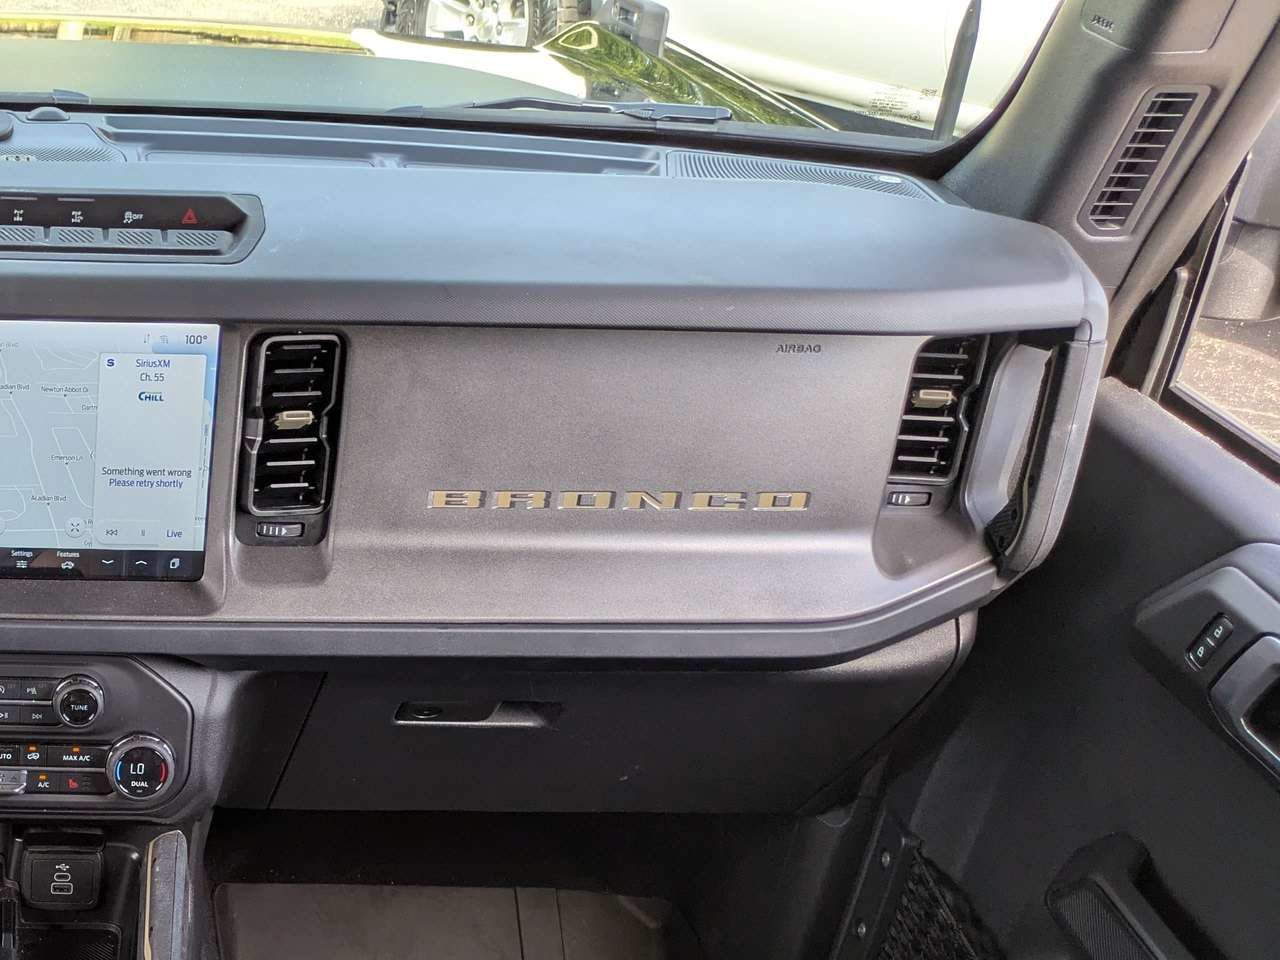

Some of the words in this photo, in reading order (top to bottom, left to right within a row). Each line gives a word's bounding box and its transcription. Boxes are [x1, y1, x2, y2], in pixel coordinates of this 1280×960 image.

[185, 334, 208, 345] 100°
[136, 358, 171, 368] SiriusXM
[140, 372, 152, 382] Ch.
[154, 372, 165, 382] 55
[16, 383, 30, 391] Blvd
[101, 466, 145, 478] Something
[145, 468, 166, 477] went
[167, 469, 192, 479] wrong
[108, 478, 135, 488] Please
[136, 479, 154, 489] retry
[155, 479, 183, 489] shortly
[426, 488, 812, 513] BRONCO
[166, 530, 183, 538] Live
[10, 549, 34, 558] Settings
[56, 550, 80, 558] Features
[78, 754, 91, 762] A/C
[130, 763, 145, 775] LO
[37, 781, 50, 789] A/C
[130, 780, 149, 788] DUAL
